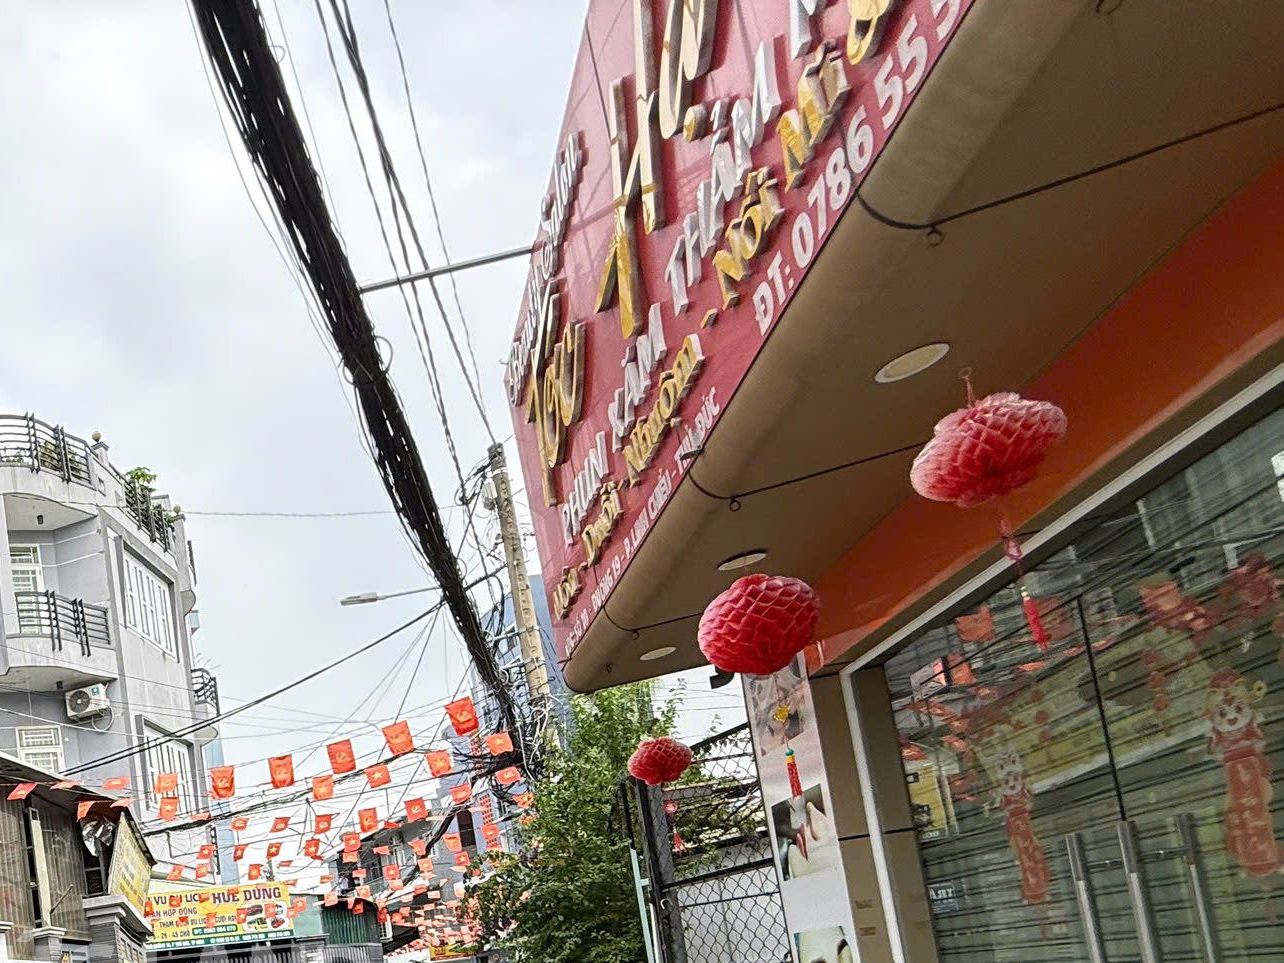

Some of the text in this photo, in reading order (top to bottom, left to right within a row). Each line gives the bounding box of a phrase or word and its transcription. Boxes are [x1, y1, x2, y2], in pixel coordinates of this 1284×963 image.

[792, 104, 874, 268] 0786
[562, 431, 610, 548] PHUN
[608, 302, 667, 453] XĂM
